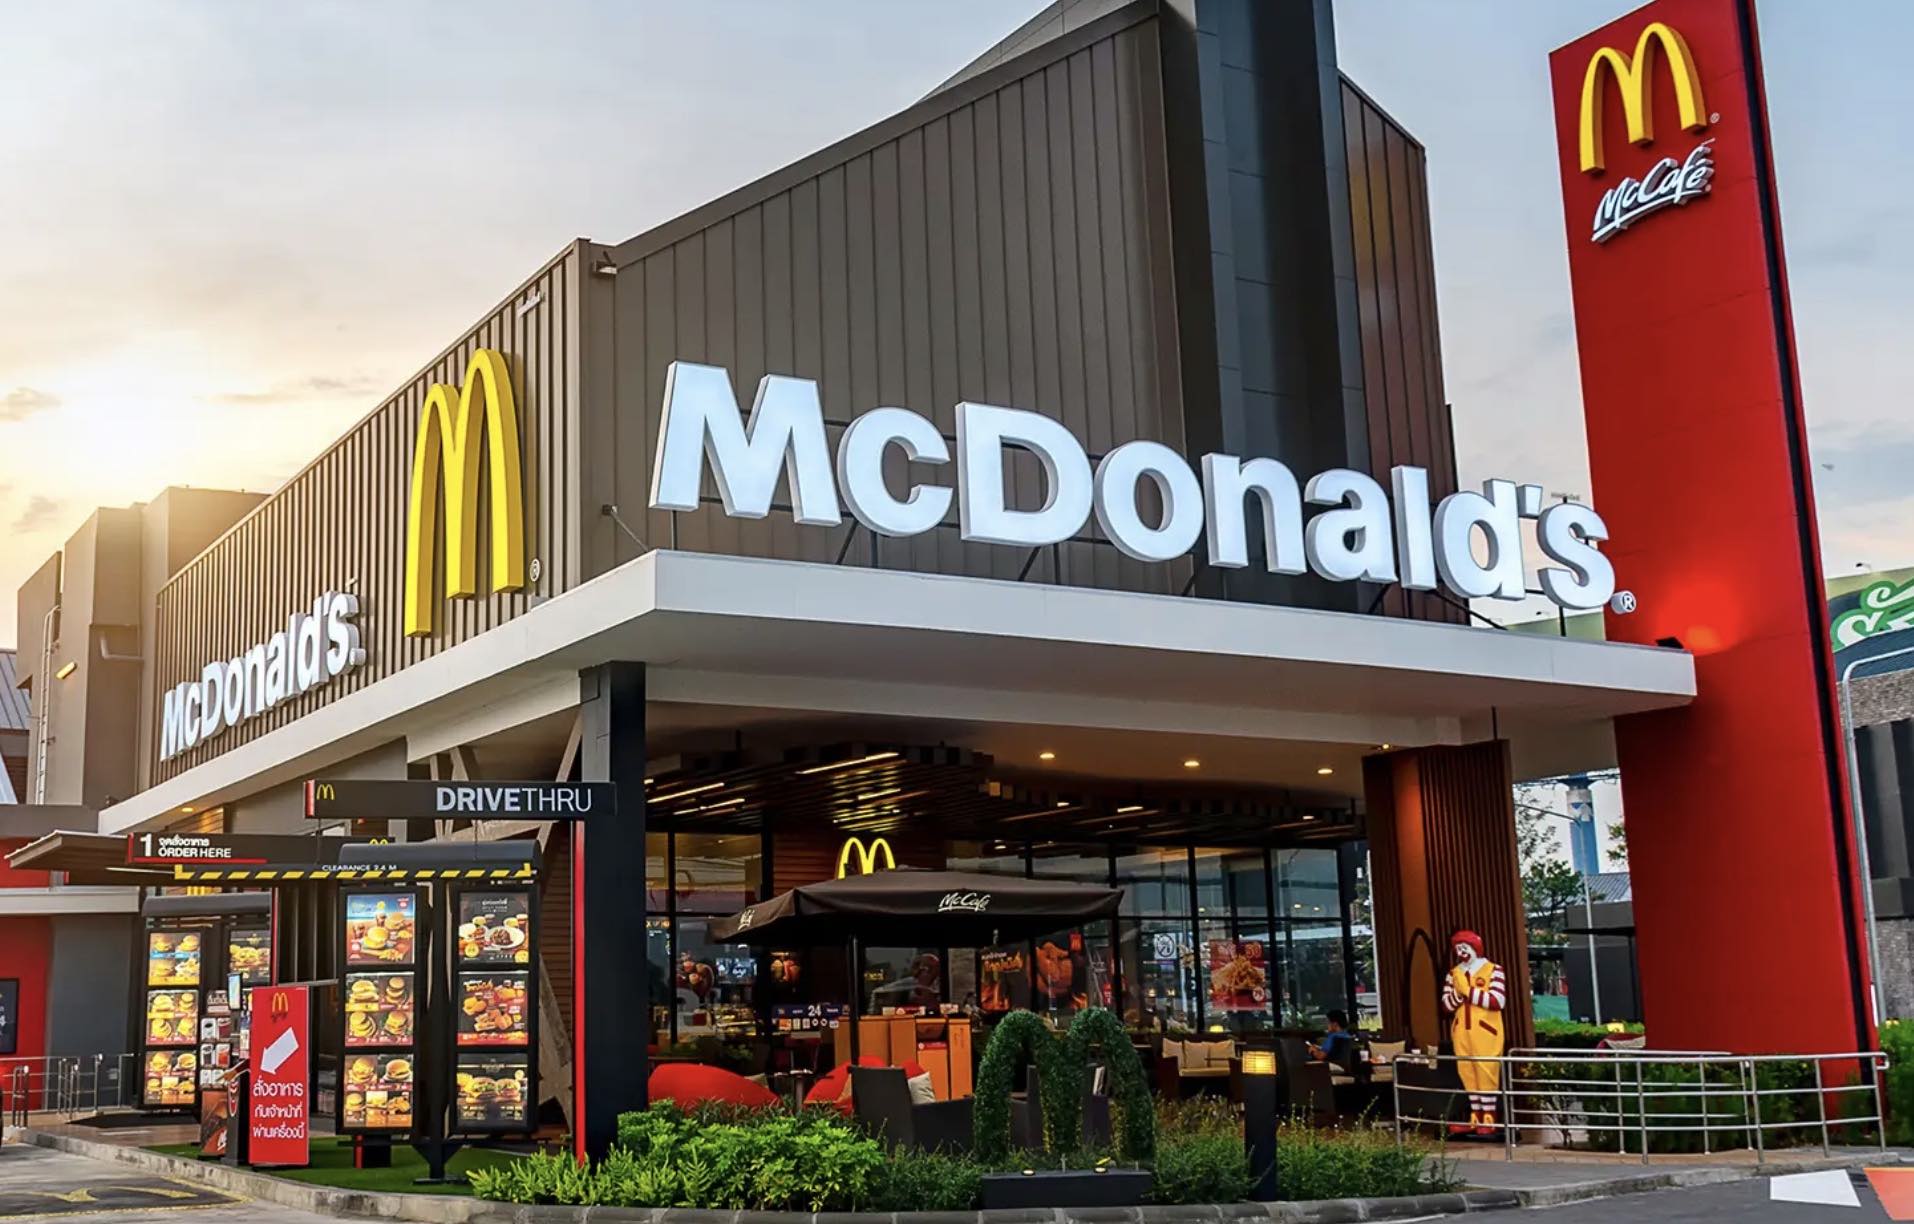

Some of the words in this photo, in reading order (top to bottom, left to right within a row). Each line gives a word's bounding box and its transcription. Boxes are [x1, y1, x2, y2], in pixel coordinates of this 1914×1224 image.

[1591, 138, 1716, 243] McCafé
[649, 361, 1616, 609] McDonald's
[160, 590, 366, 762] McDonald's
[140, 833, 152, 857] 1
[158, 847, 198, 858] ORDER
[200, 847, 232, 858] HERE
[321, 864, 370, 872] CLEARANCE
[807, 1004, 822, 1017] 24
[253, 1075, 304, 1096] สั่งอาหาร
